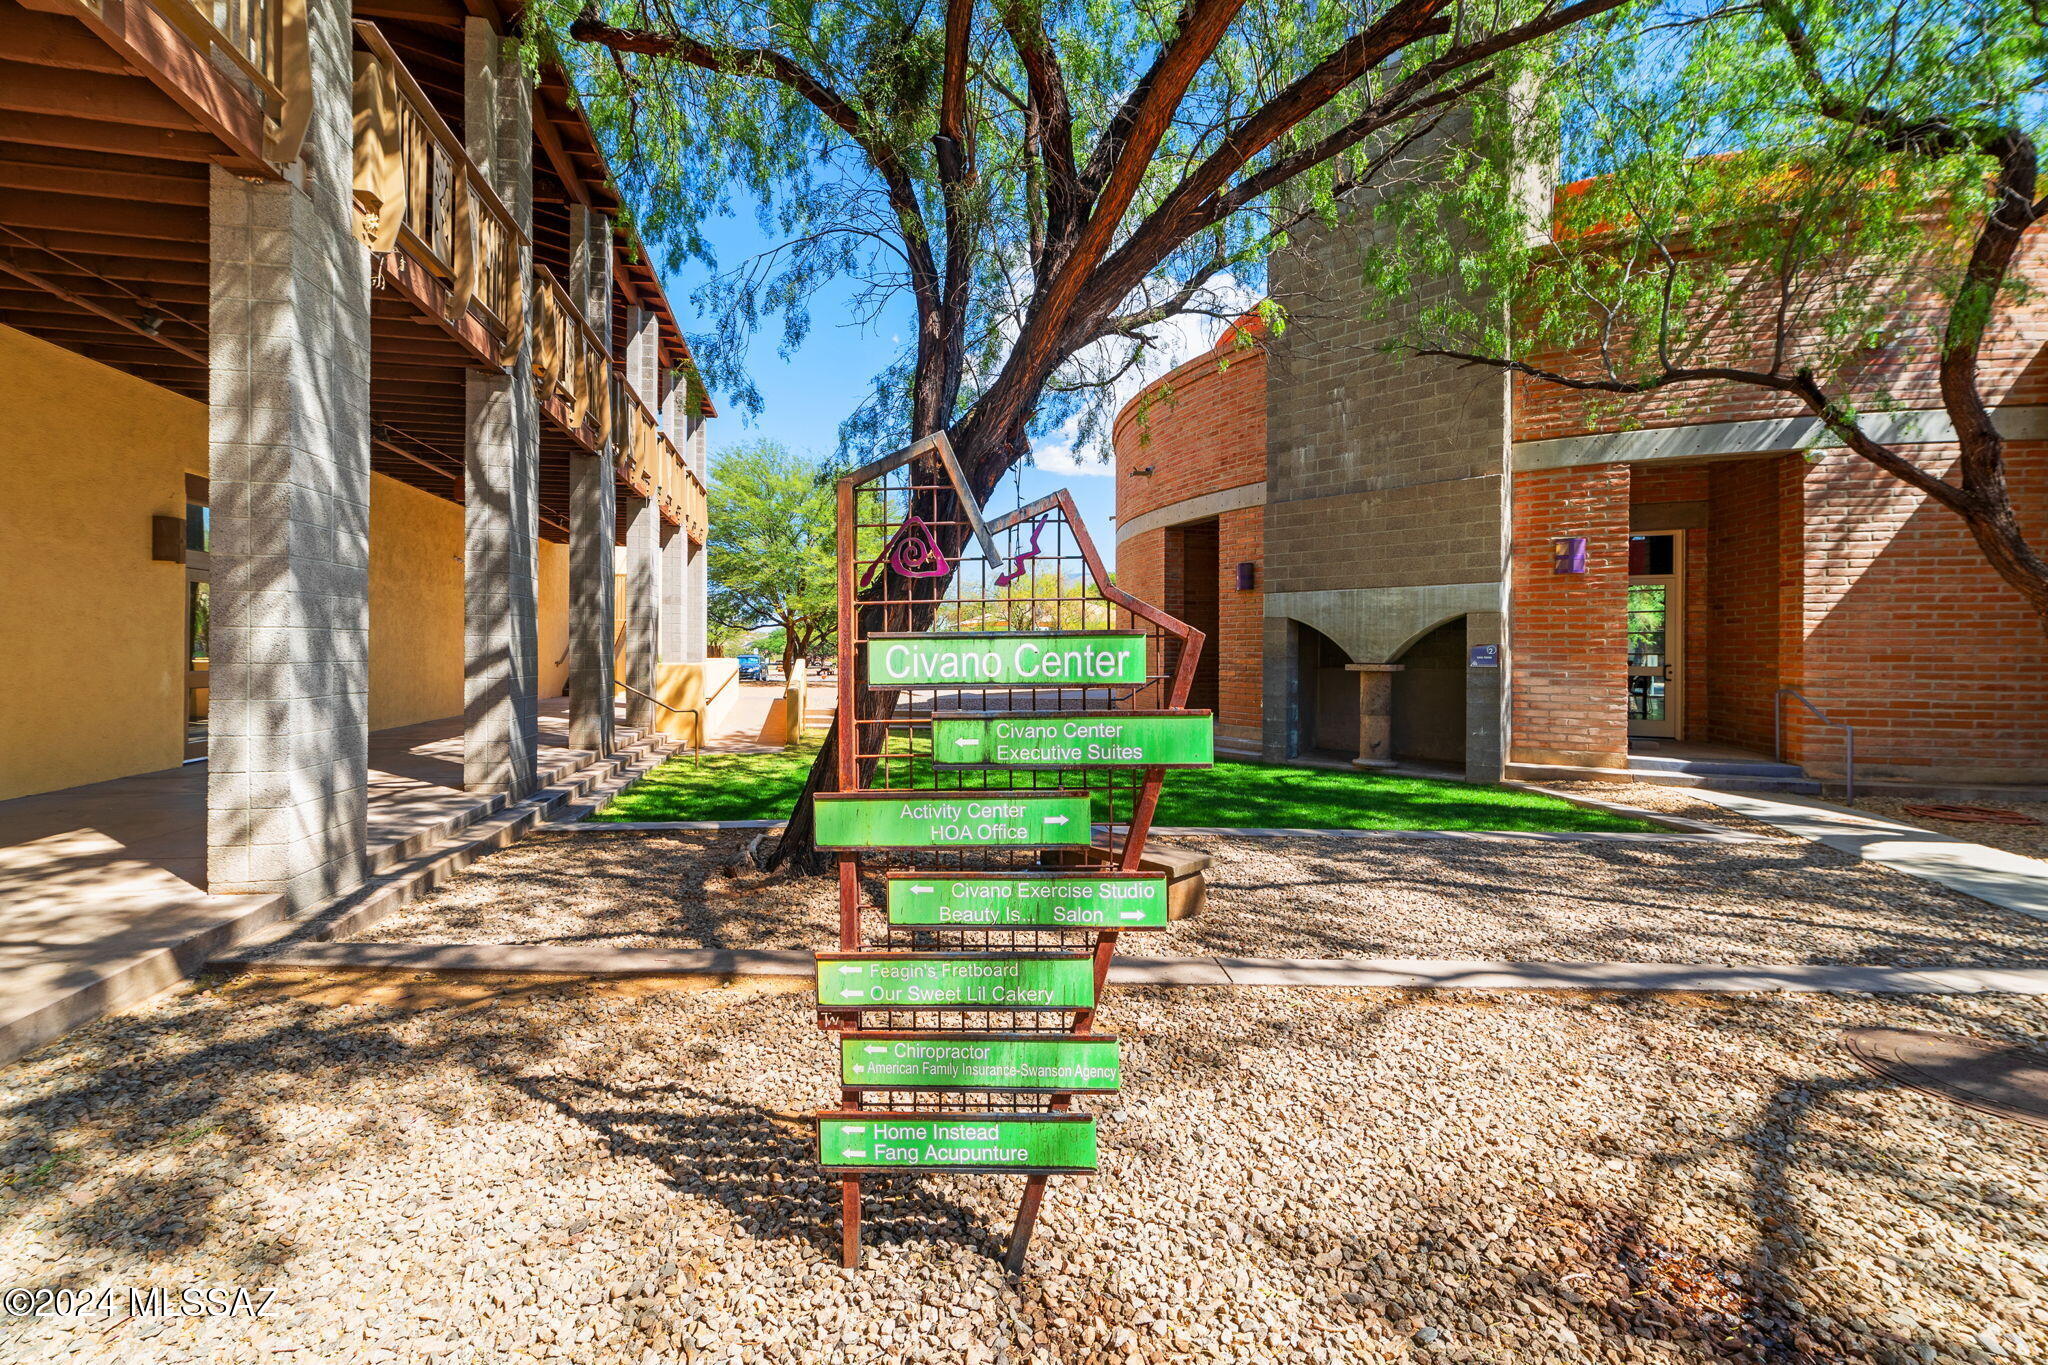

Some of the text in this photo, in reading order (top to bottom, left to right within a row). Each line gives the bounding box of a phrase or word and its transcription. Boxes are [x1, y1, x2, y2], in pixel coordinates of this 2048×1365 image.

[885, 643, 1130, 678] Civano Center
[996, 724, 1122, 739] Civano Center
[997, 745, 1142, 760] Executive Suites
[900, 804, 1026, 821] Activity Center
[931, 824, 1027, 840] HOA Office
[951, 883, 1154, 899] Civano Exercise Studio
[939, 907, 1103, 925] Beauty Is... Salon
[870, 964, 1019, 981] Feagin's Fretboard
[870, 985, 1054, 1004] Our Sweet Lil Cakery
[894, 1043, 990, 1060] Chiropractor
[867, 1062, 1117, 1081] American Family Insurance-Swanson Agency
[874, 1124, 999, 1140] Home Instead
[874, 1144, 1029, 1164] Fang Acupunture
